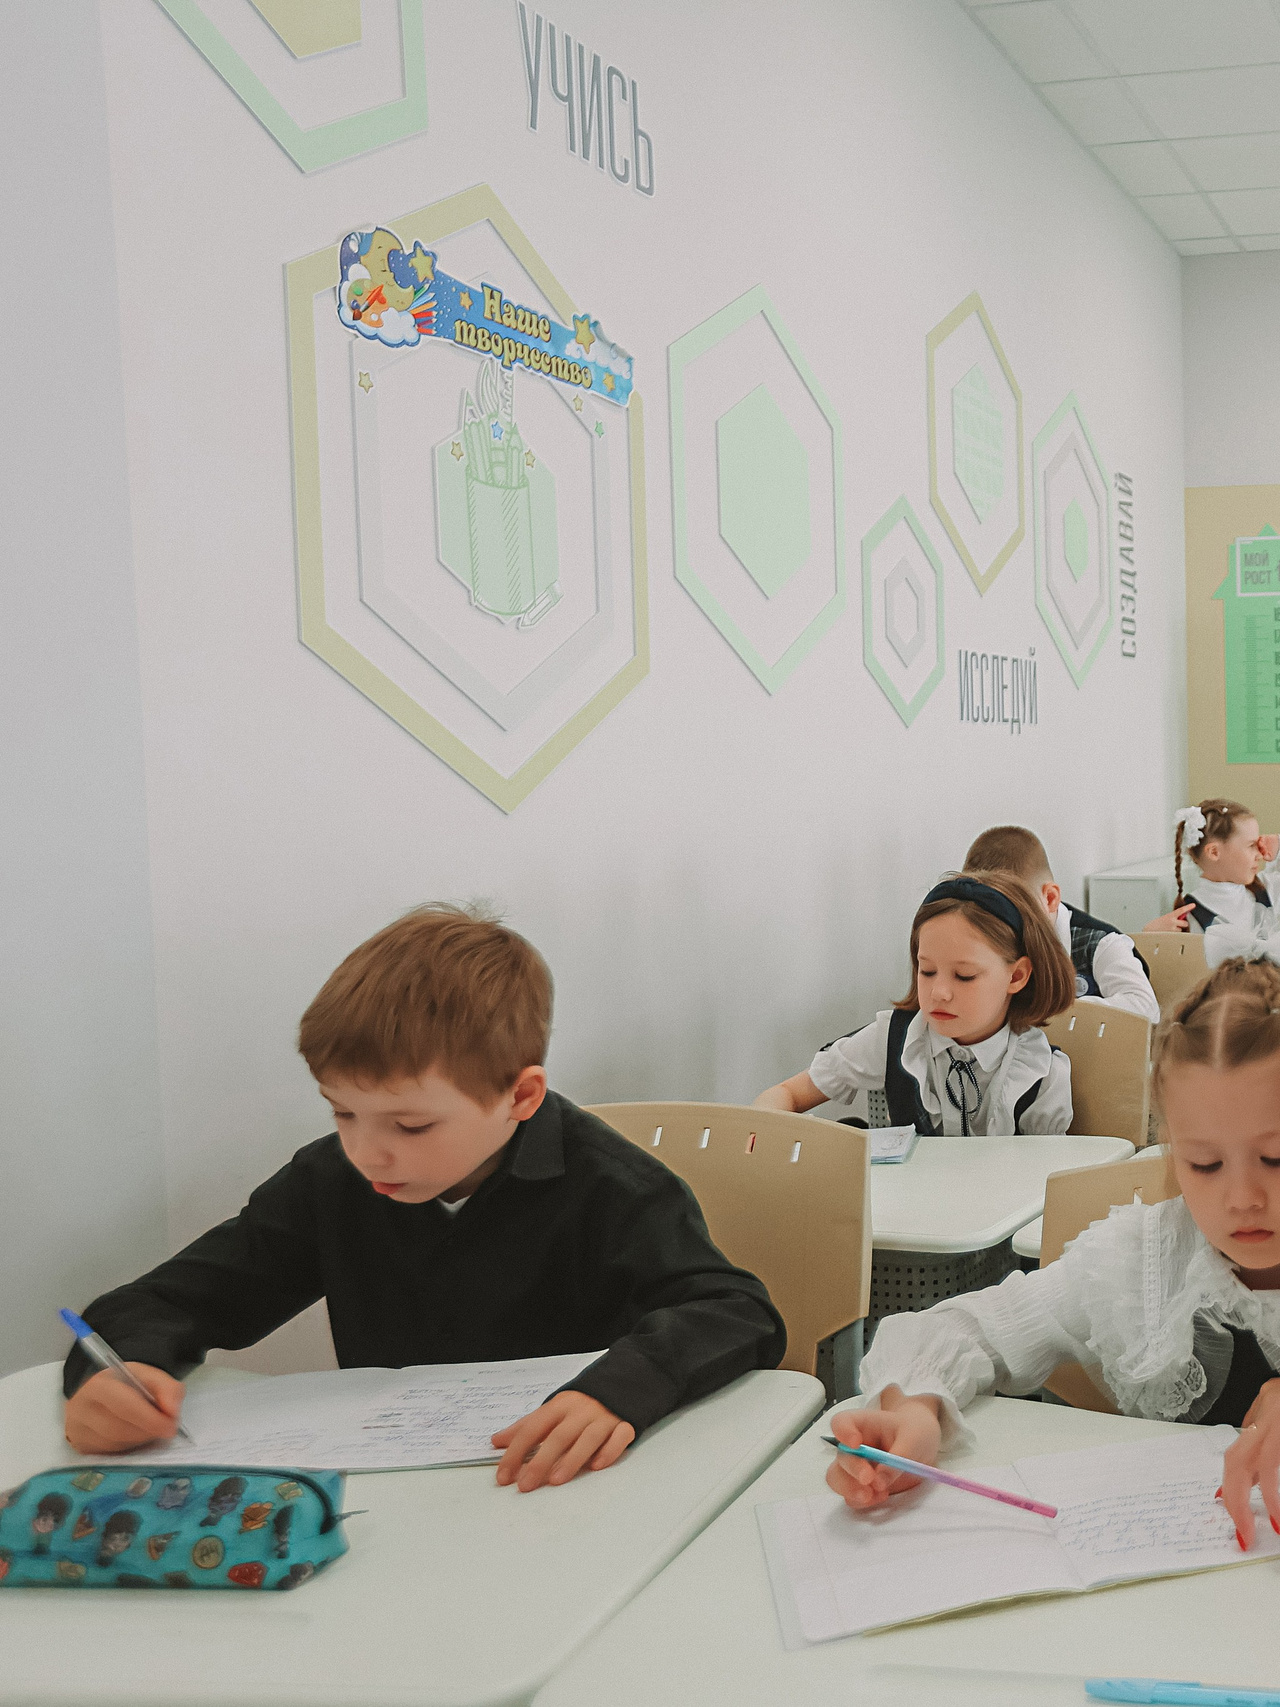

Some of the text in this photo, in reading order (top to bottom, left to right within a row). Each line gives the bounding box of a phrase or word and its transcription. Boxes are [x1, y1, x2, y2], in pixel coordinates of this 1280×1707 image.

[518, 0, 655, 197] УЧИСЬ
[482, 285, 552, 343] Наше
[453, 319, 593, 389] творчество
[1114, 472, 1138, 659] СОЗДАВАЙ
[1244, 549, 1269, 567] МОЙ
[1244, 570, 1271, 585] РОСТ
[958, 647, 1038, 734] ИССЛЕДУЙ
